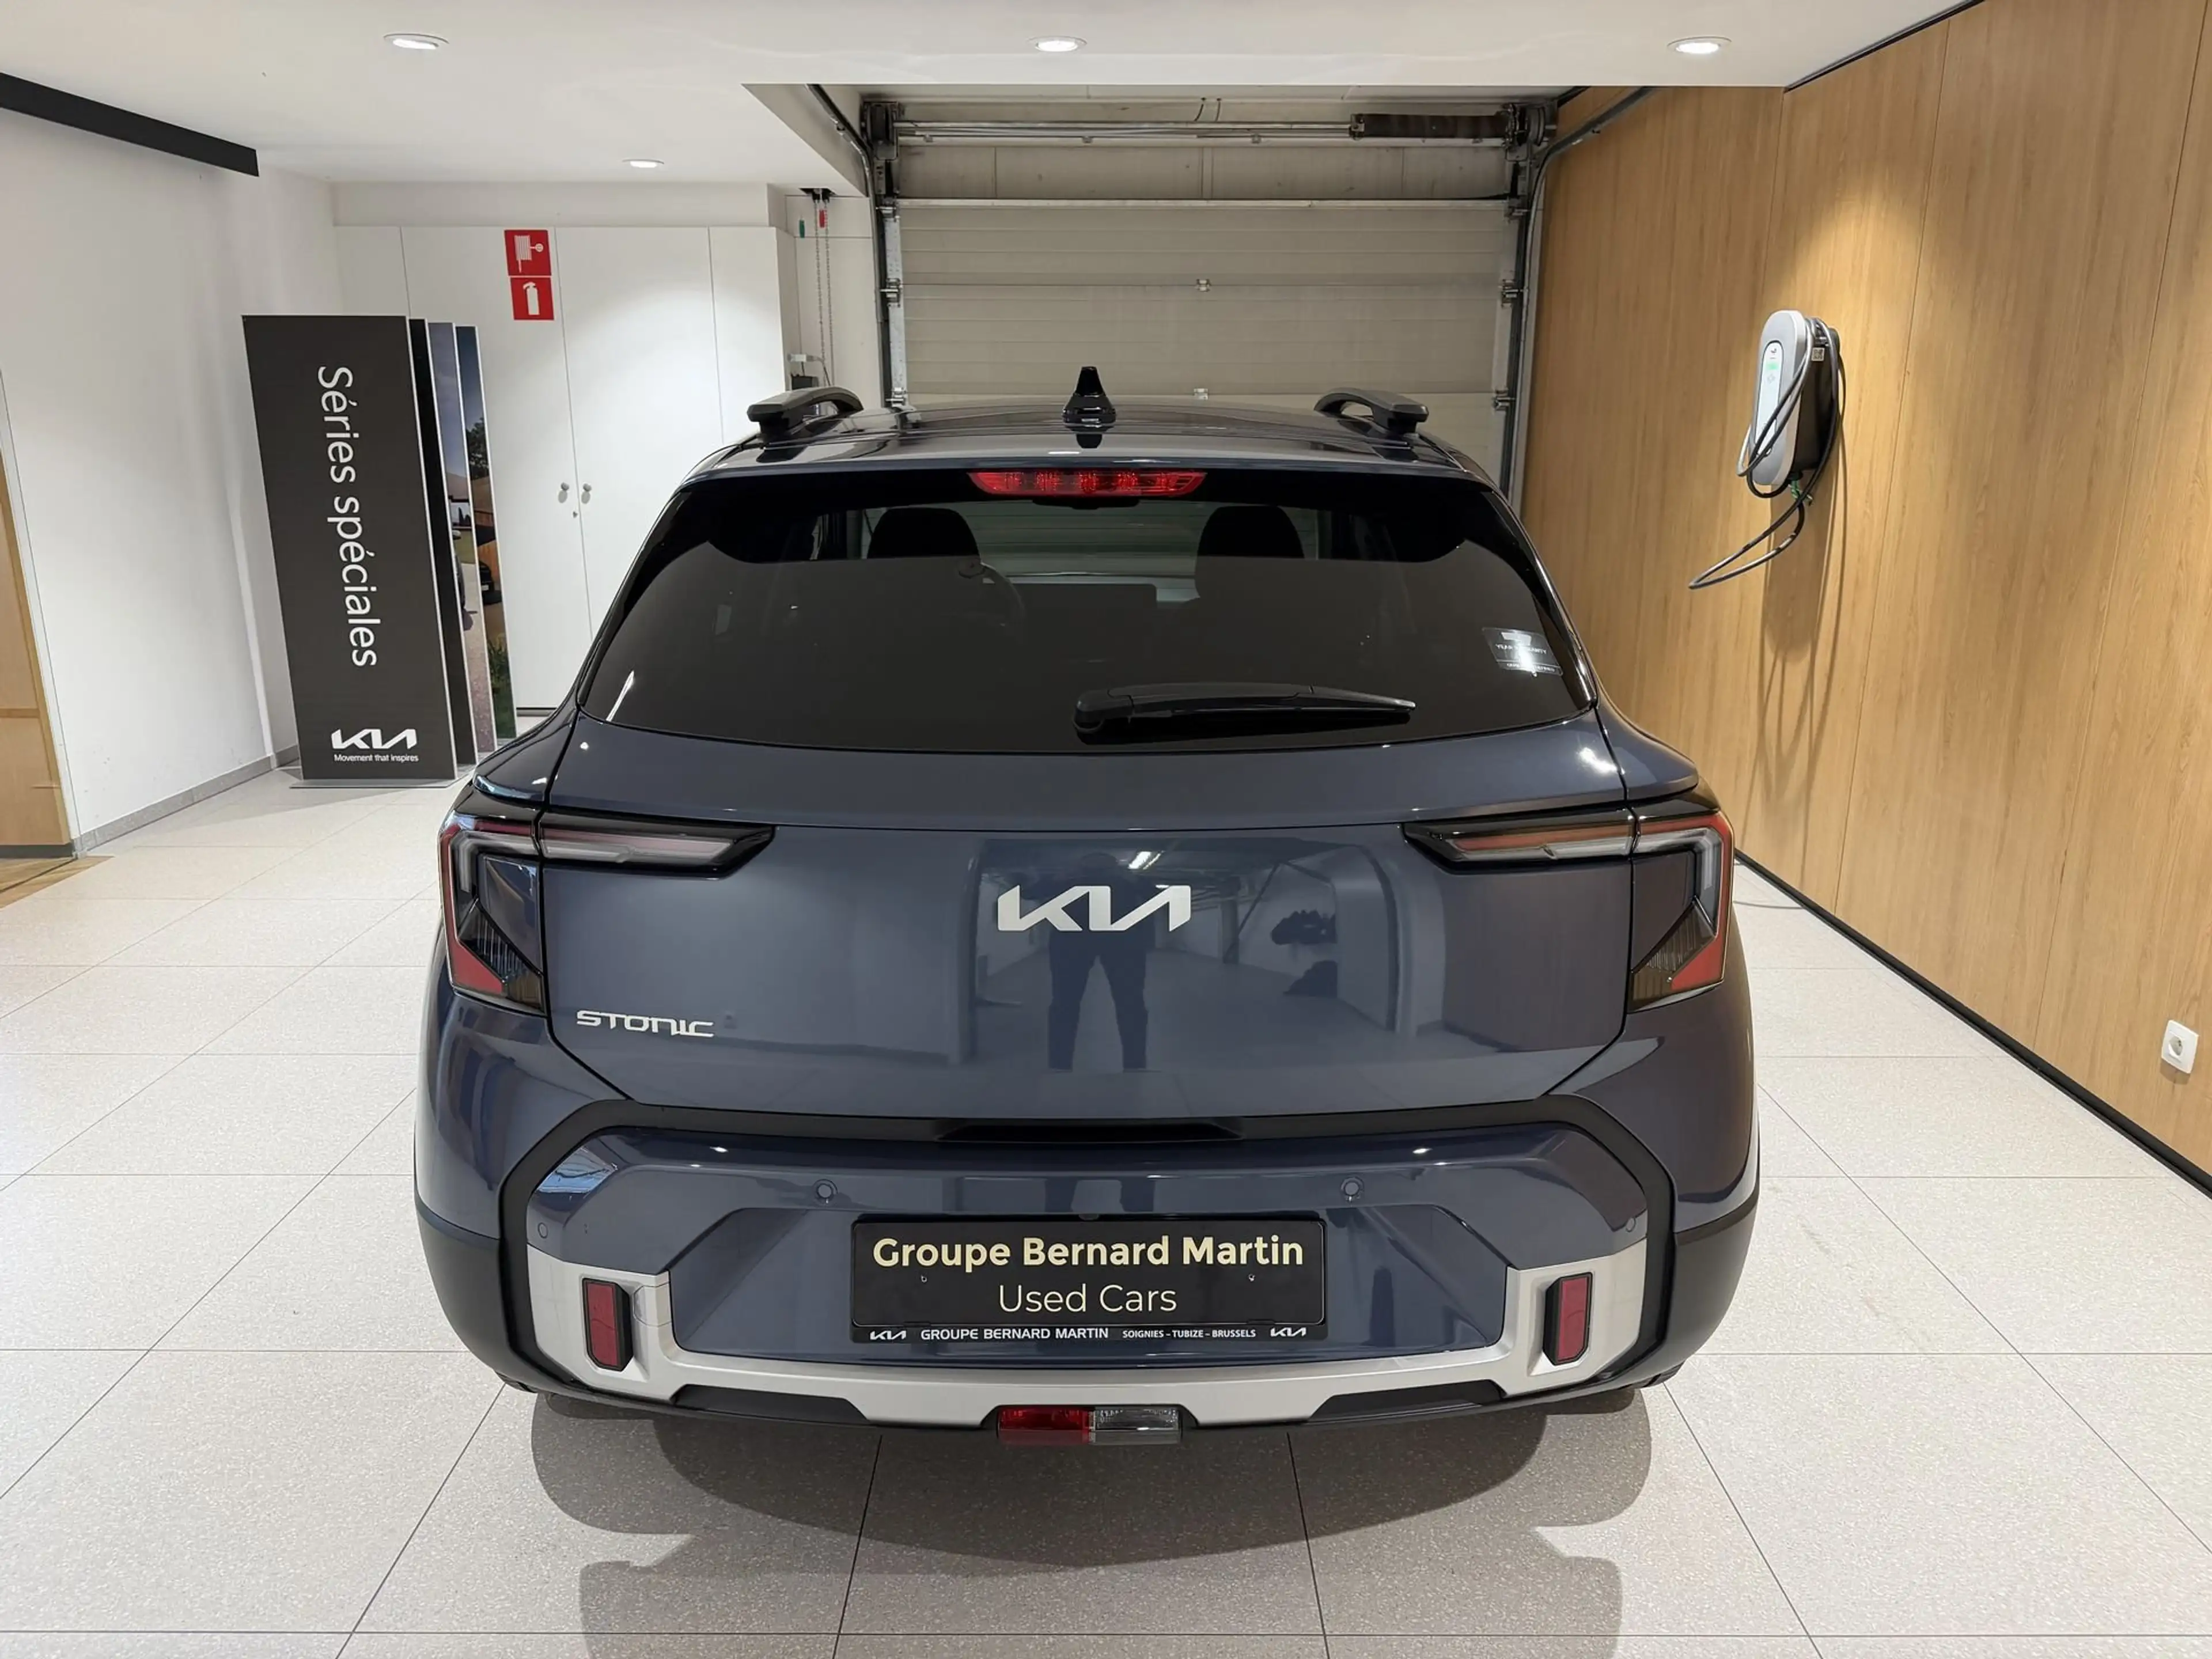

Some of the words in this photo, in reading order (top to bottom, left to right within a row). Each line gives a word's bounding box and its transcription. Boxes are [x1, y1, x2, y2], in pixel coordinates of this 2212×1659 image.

[318, 366, 359, 483] Séries
[327, 497, 381, 666] spéciales
[331, 729, 417, 749] KIA
[334, 754, 373, 762] Movement
[391, 754, 419, 763] inspires
[997, 884, 1191, 931] KIA
[577, 1010, 714, 1037] STONIC
[873, 1238, 1010, 1273] Groupe
[1024, 1235, 1169, 1266] Bernard
[1183, 1234, 1303, 1265] Martin
[999, 1283, 1086, 1312] Used
[1100, 1285, 1177, 1312] Cars
[870, 1330, 907, 1340] KIA
[921, 1328, 979, 1340] GROUPE
[983, 1328, 1051, 1339] BERNARD
[1055, 1327, 1108, 1339] MARTIN
[1122, 1330, 1164, 1339] SOIGNIES
[1172, 1329, 1204, 1338] TUBIZE
[1211, 1329, 1256, 1338] BRUSSELS
[1270, 1327, 1306, 1337] KIA
